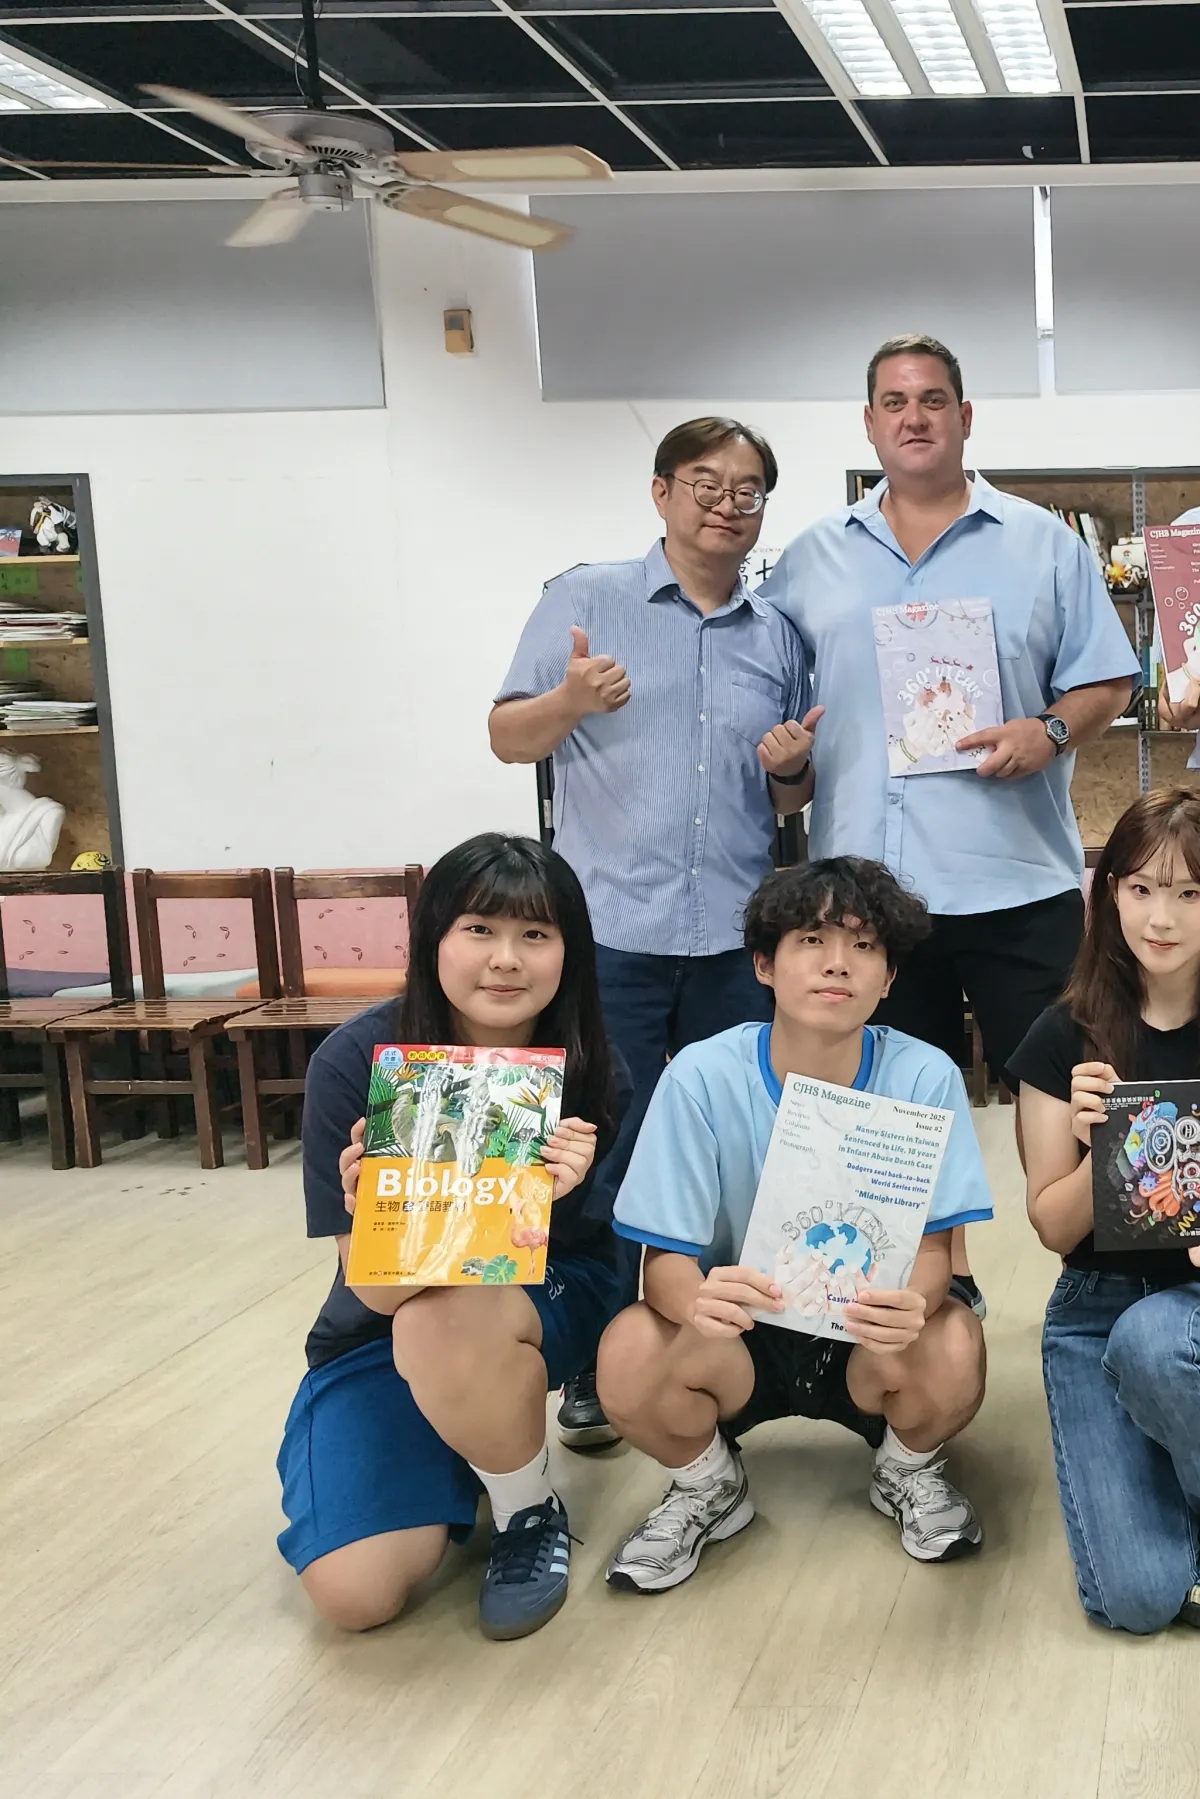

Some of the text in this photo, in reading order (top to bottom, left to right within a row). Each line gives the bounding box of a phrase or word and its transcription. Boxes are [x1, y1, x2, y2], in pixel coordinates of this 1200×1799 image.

[900, 604, 940, 614] Magazine
[794, 1082, 872, 1110] CJHS Magazine
[893, 1106, 946, 1122] November 2025
[916, 1122, 934, 1132] Issue
[856, 1125, 879, 1136] Nanny
[880, 1130, 904, 1141] Sisters
[914, 1136, 940, 1148] Taiwan
[780, 1138, 816, 1154] Photography
[844, 1134, 881, 1148] Sentenced
[882, 1141, 890, 1150] to
[917, 1150, 937, 1159] years
[846, 1146, 870, 1159] Infant
[871, 1152, 893, 1162] Abuse
[894, 1156, 914, 1167] Death
[916, 1160, 933, 1170] Case
[847, 1162, 873, 1176] Dodgers
[874, 1168, 887, 1177] seal
[376, 1168, 518, 1205] Biology
[871, 1178, 928, 1194] World Series titles
[781, 1200, 833, 1241] 360°
[828, 1294, 850, 1304] Castle
[831, 1322, 844, 1332] The
